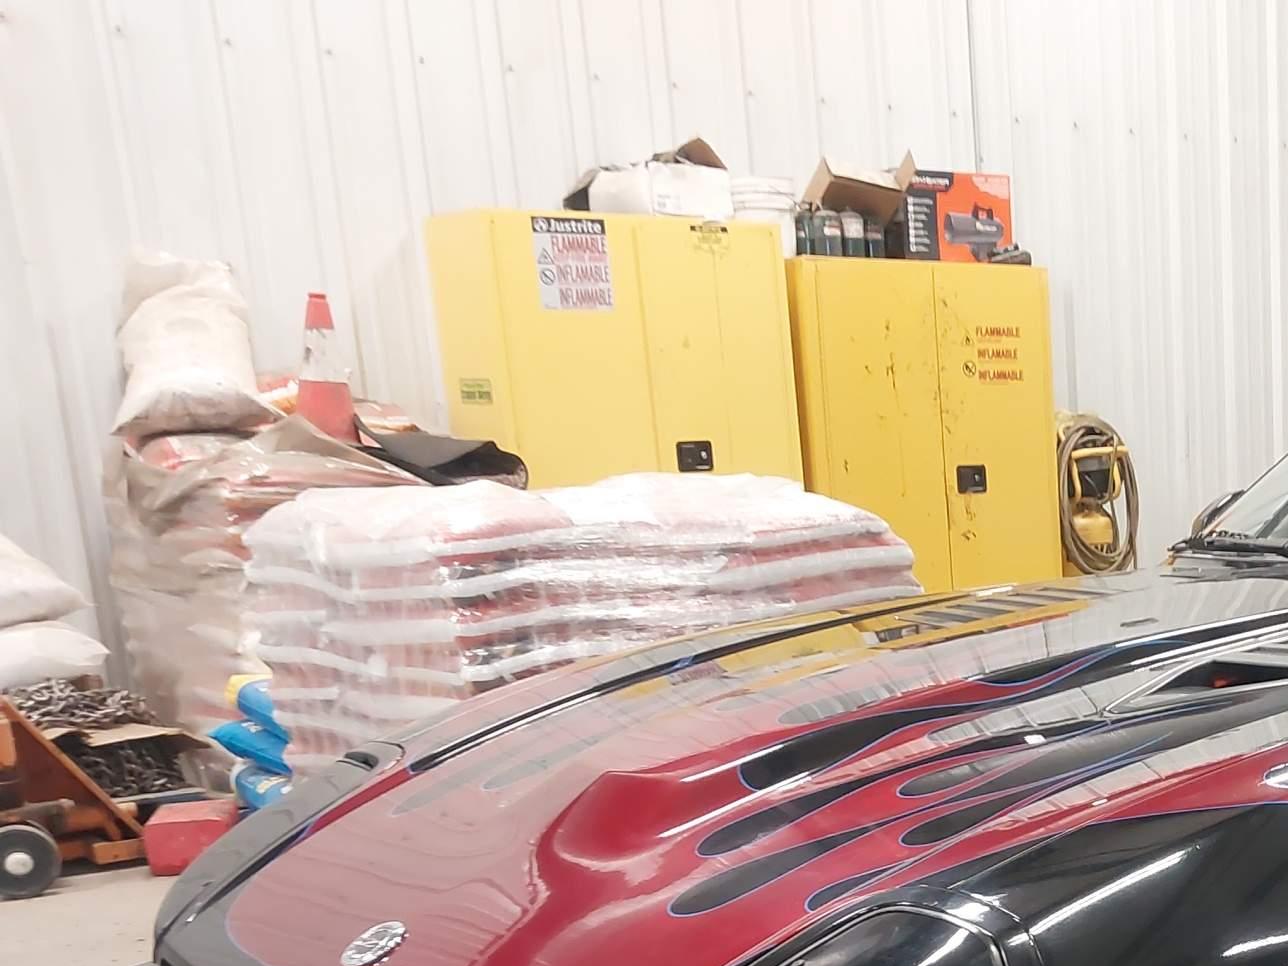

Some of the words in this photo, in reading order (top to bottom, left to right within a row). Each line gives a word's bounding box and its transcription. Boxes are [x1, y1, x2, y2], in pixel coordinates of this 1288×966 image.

[549, 219, 602, 233] Justrite
[551, 235, 606, 254] FLAMMABLE
[557, 264, 609, 283] INFLAMABLE
[560, 287, 612, 305] INFLAMMABLE
[976, 326, 1019, 338] FLAMMABLE
